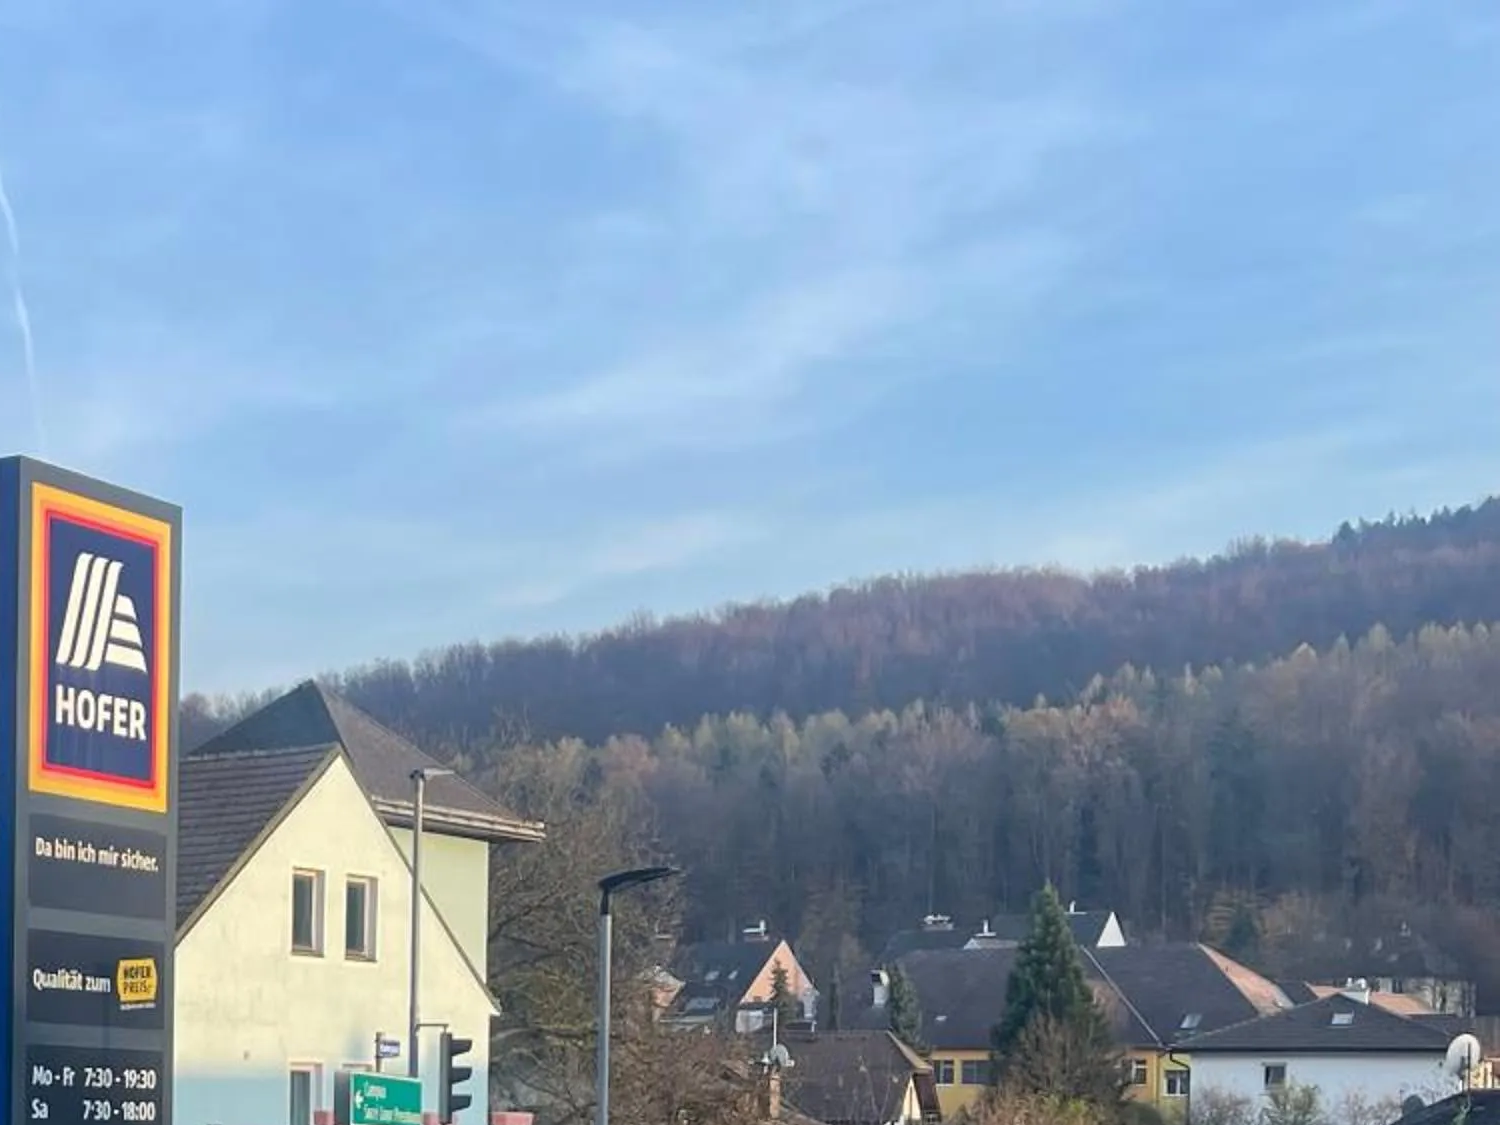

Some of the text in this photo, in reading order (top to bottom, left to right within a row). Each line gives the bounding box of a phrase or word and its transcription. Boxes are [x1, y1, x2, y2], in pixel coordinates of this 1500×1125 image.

[55, 684, 147, 741] HOFER
[35, 836, 159, 872] Da bin ich mir sicher.
[33, 968, 111, 993] Qualität zum
[31, 1065, 53, 1086] Mo
[62, 1067, 76, 1086] Fr
[83, 1067, 113, 1088] 7:30
[123, 1069, 157, 1089] 19:30
[31, 1098, 49, 1119] Sa
[122, 1101, 156, 1121] 18:00
